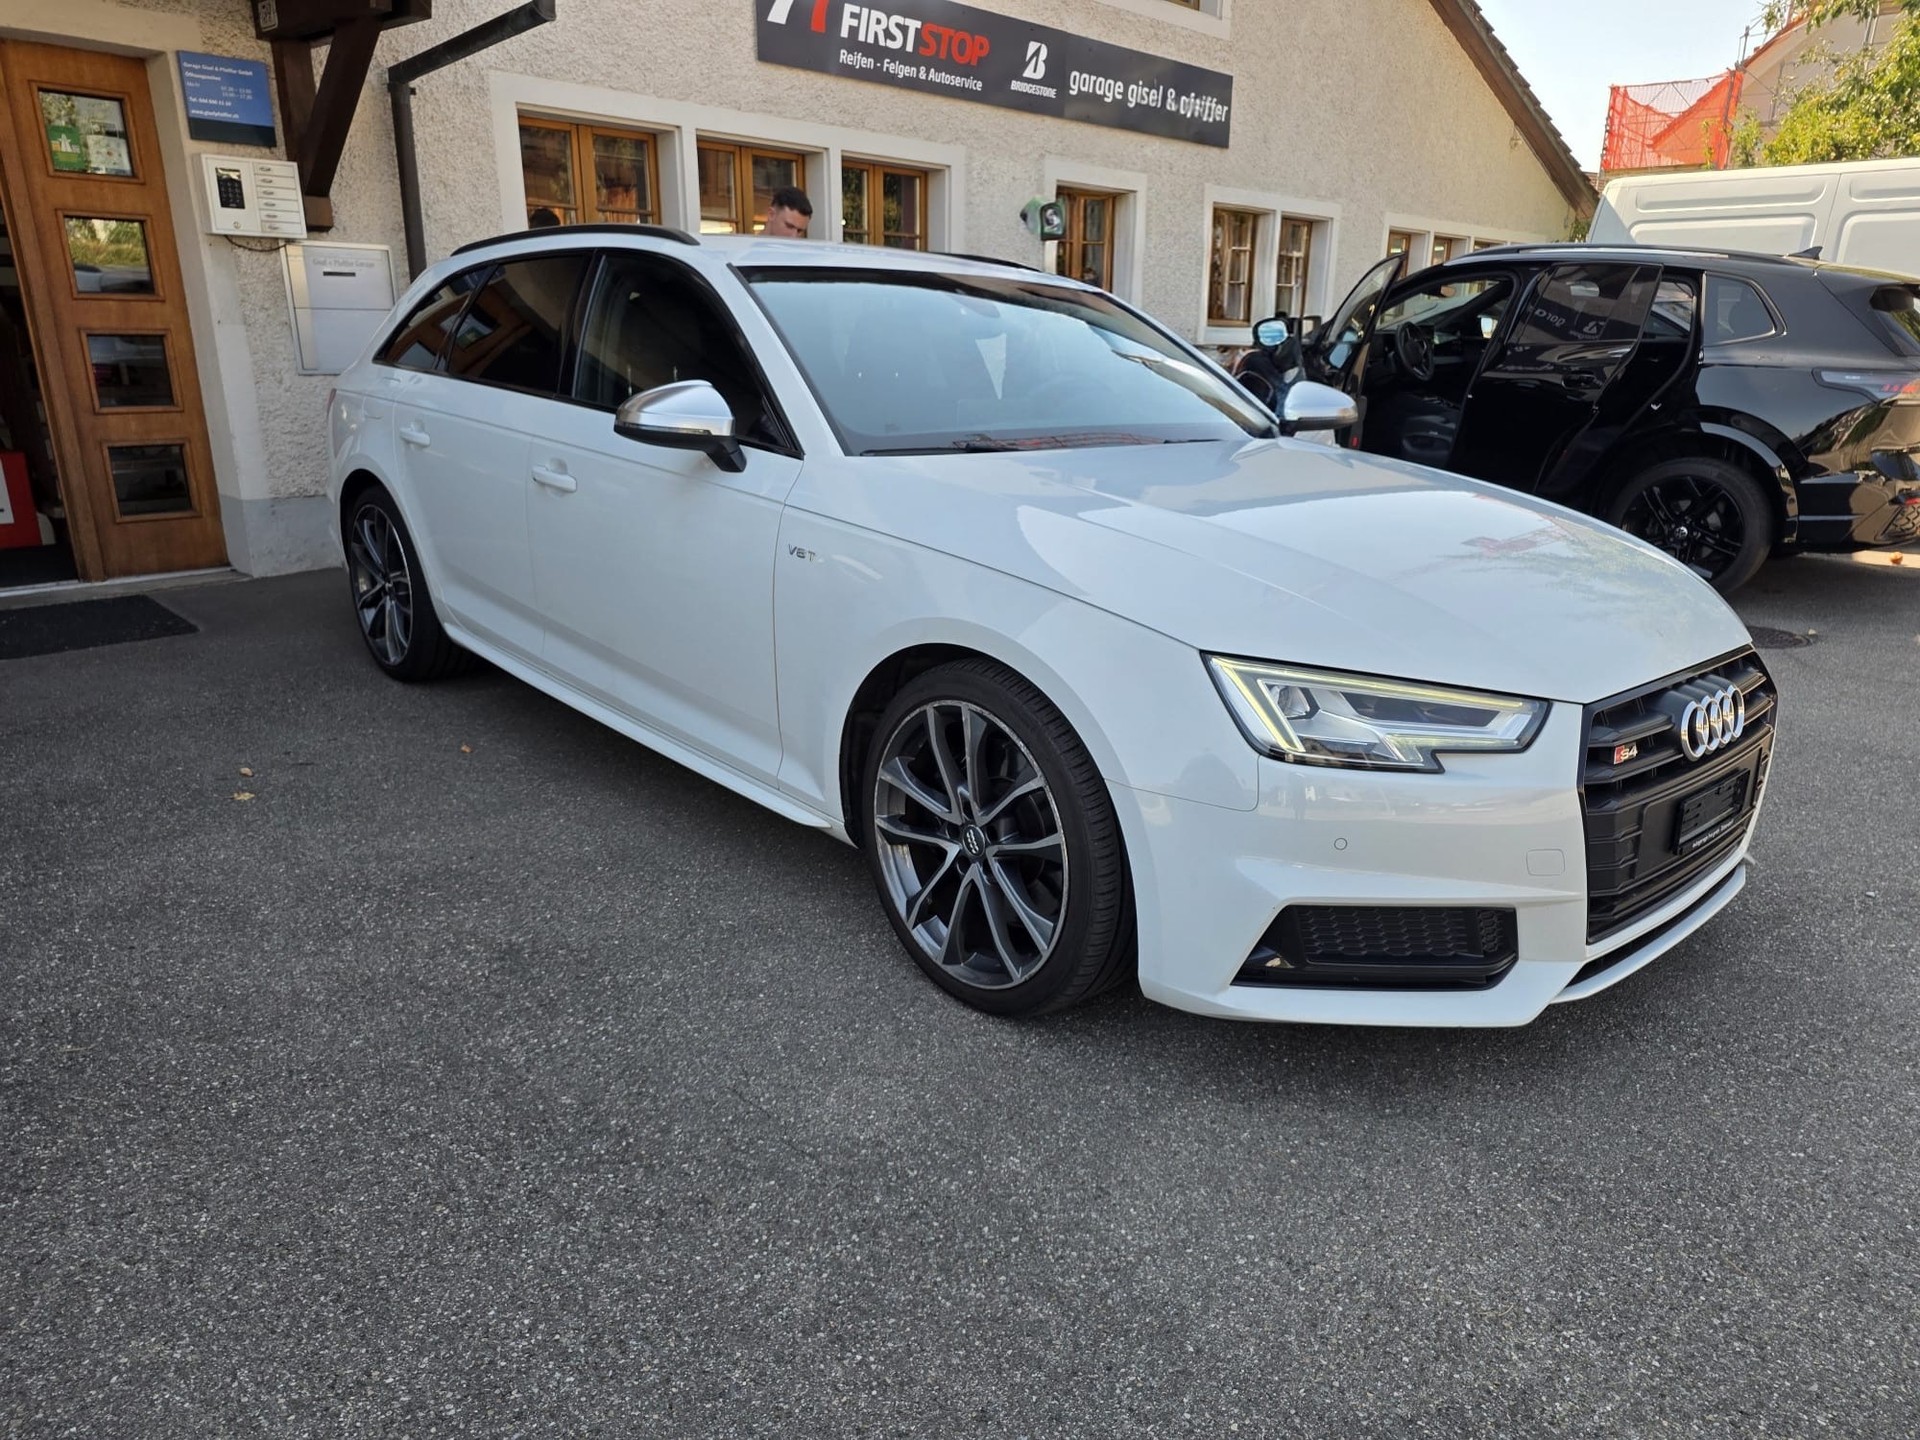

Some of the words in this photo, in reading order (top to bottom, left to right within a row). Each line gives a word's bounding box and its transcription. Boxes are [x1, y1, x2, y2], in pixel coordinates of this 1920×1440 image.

[839, 49, 874, 70] Reifen
[883, 59, 917, 79] Felgen
[919, 66, 927, 80] &
[928, 67, 983, 92] Autoservice
[1011, 80, 1057, 99] BRIDGESTONE
[1069, 70, 1124, 103] garage
[1127, 80, 1163, 108] gisel
[1166, 88, 1178, 111] &
